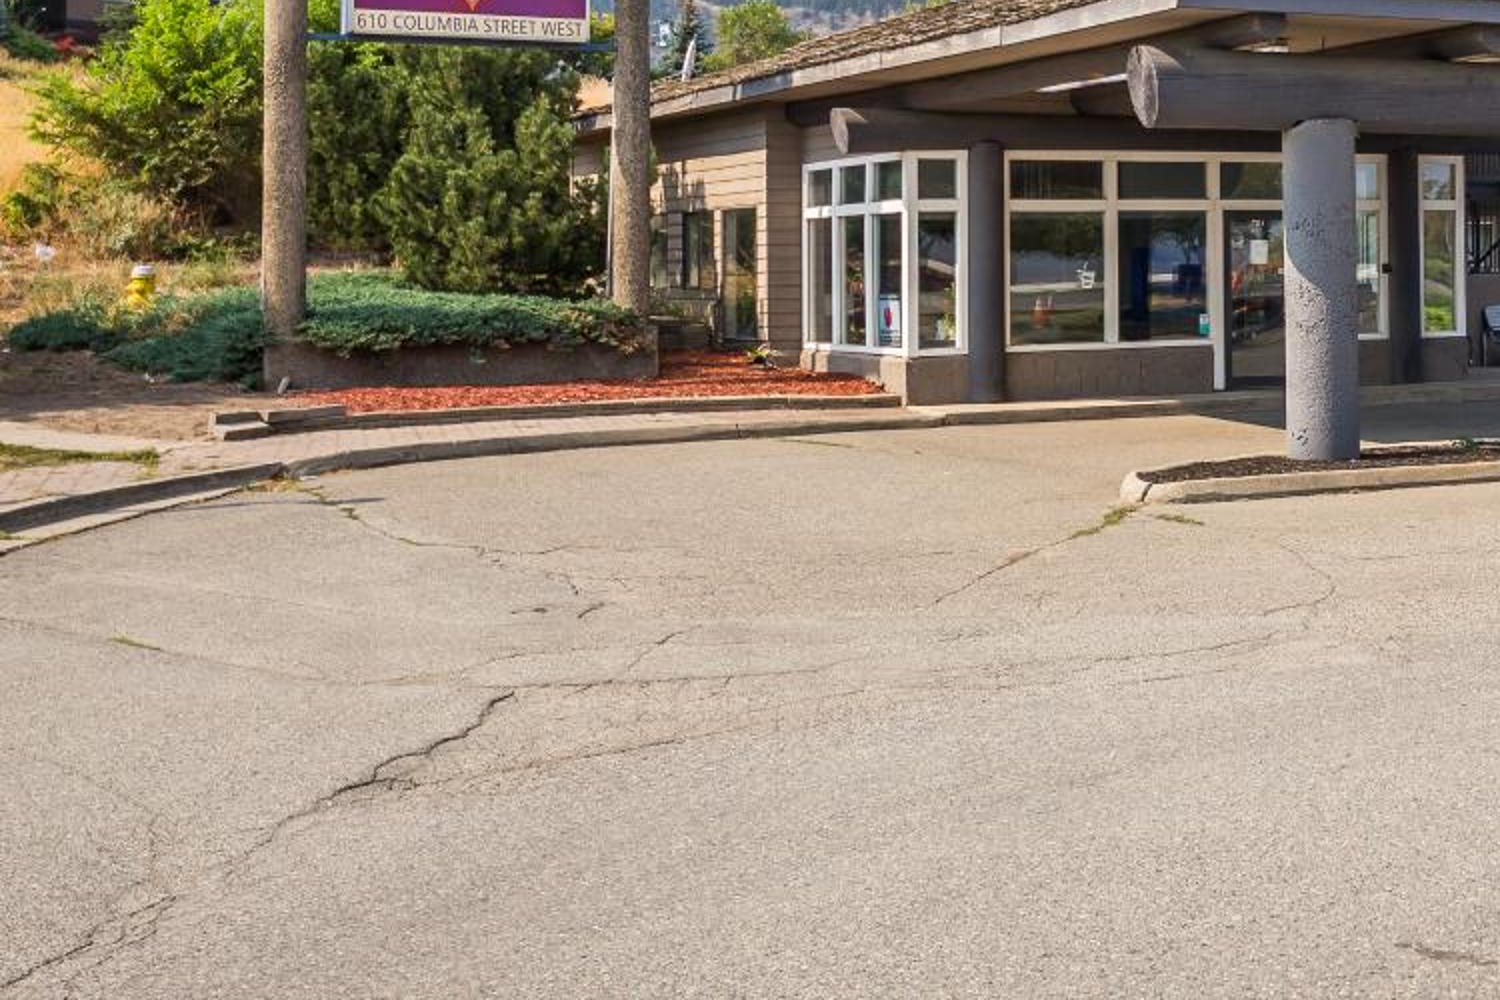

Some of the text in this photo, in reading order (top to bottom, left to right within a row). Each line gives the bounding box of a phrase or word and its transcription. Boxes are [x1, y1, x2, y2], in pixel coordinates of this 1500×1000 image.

[357, 13, 583, 37] 610 COLUMBIA STREET WEST
